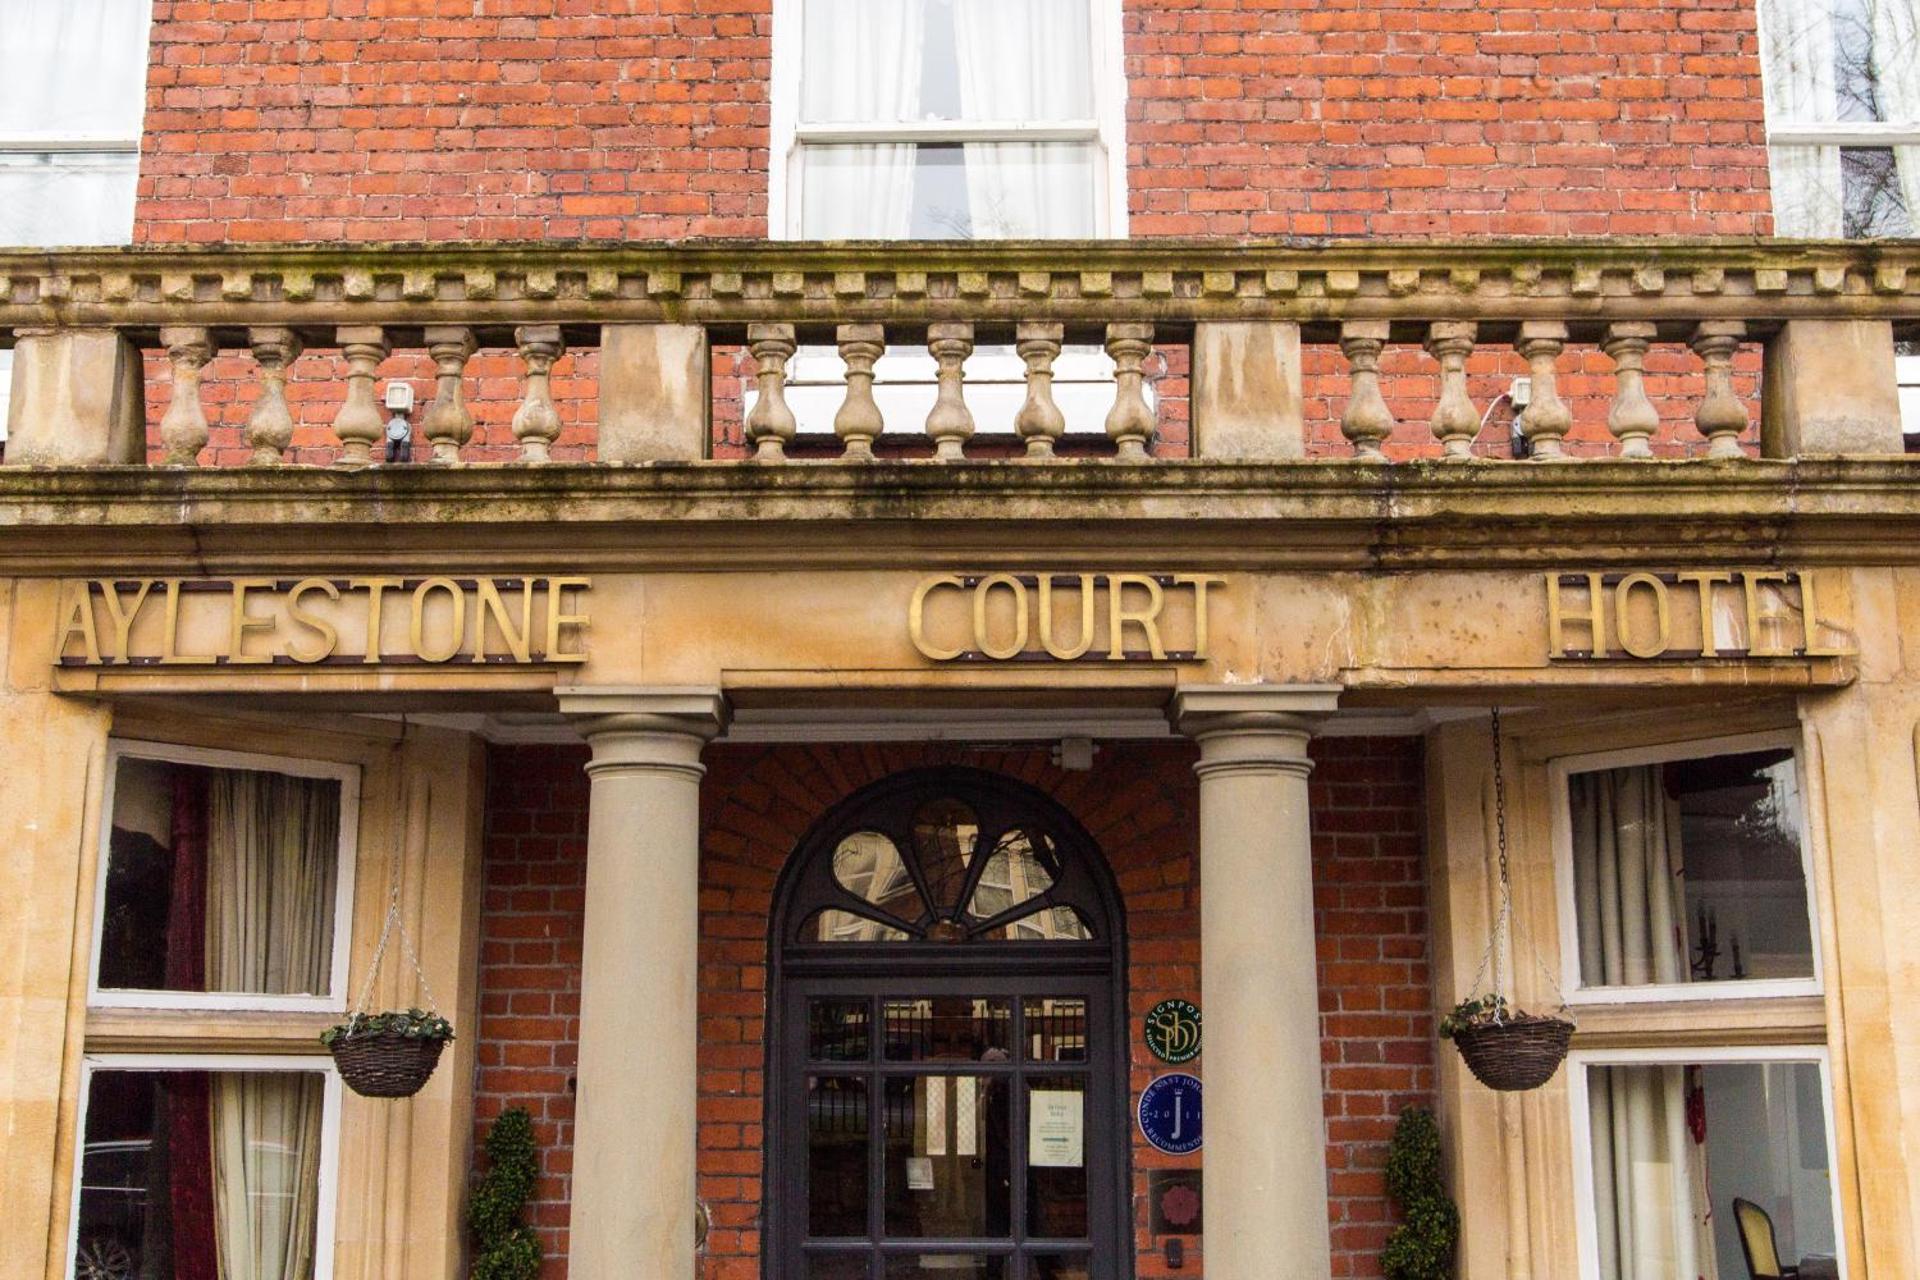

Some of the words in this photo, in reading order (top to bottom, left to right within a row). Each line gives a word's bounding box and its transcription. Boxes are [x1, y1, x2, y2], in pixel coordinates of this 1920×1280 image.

[53, 575, 592, 665] AYLESTONE
[908, 572, 1228, 661] COURT
[1545, 570, 1859, 659] HOTEL
